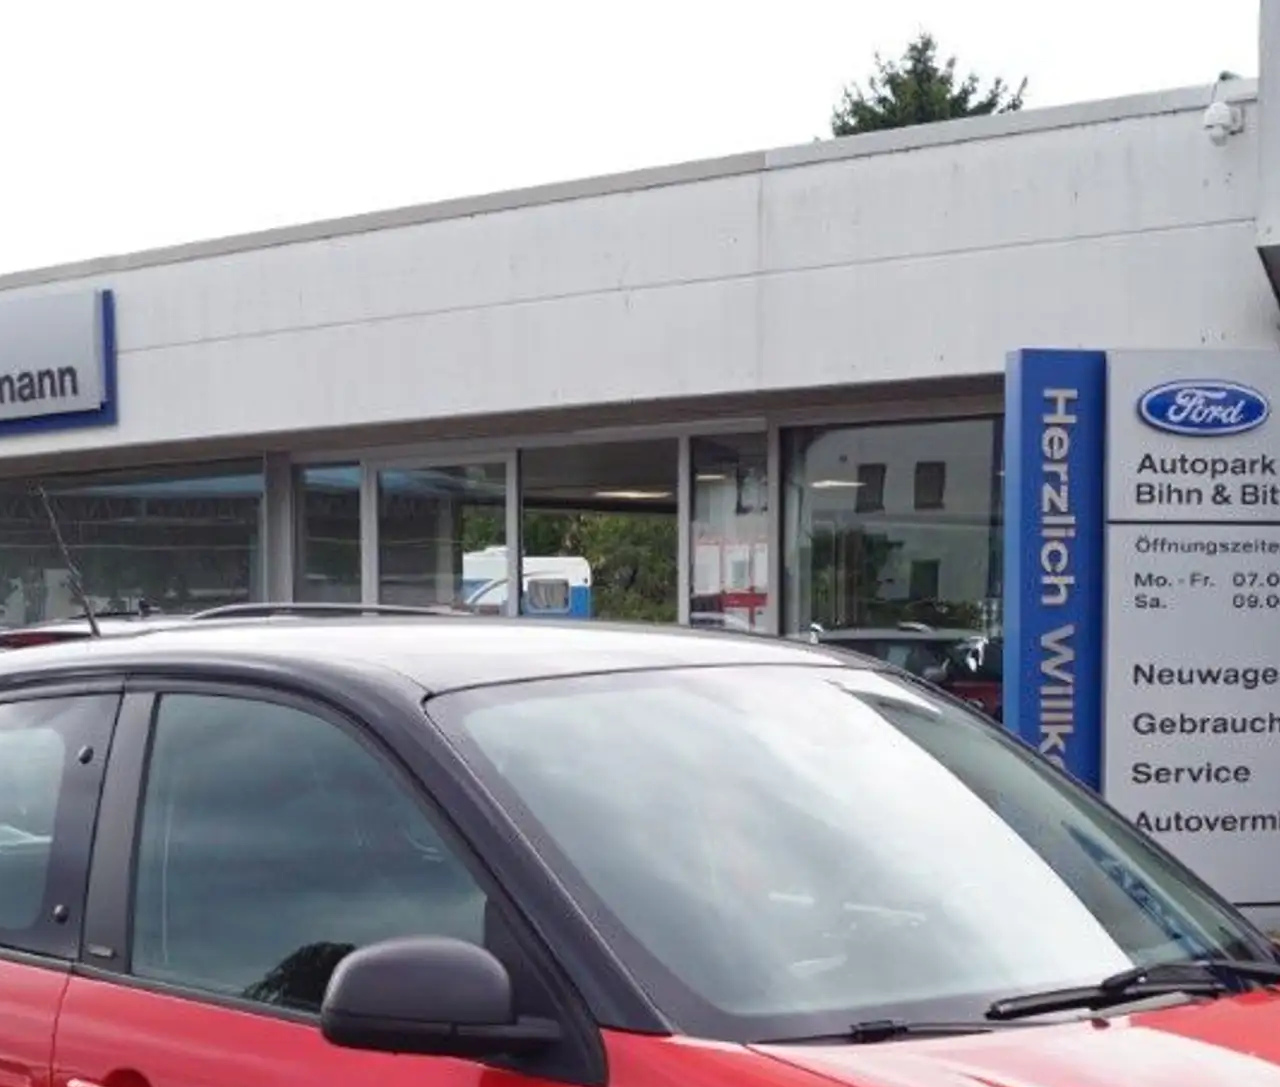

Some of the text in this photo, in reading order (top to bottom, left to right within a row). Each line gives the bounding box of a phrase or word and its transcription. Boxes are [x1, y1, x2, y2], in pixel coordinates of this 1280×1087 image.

[1166, 388, 1245, 425] Ford
[1136, 453, 1277, 479] Autopark
[1040, 387, 1078, 606] Herzlich
[1135, 482, 1203, 506] Bihn
[1211, 484, 1233, 506] &
[1133, 572, 1172, 588] Mo.
[1189, 572, 1216, 588] Fr.
[1133, 594, 1168, 610] Sa.
[1130, 761, 1252, 785] Service
